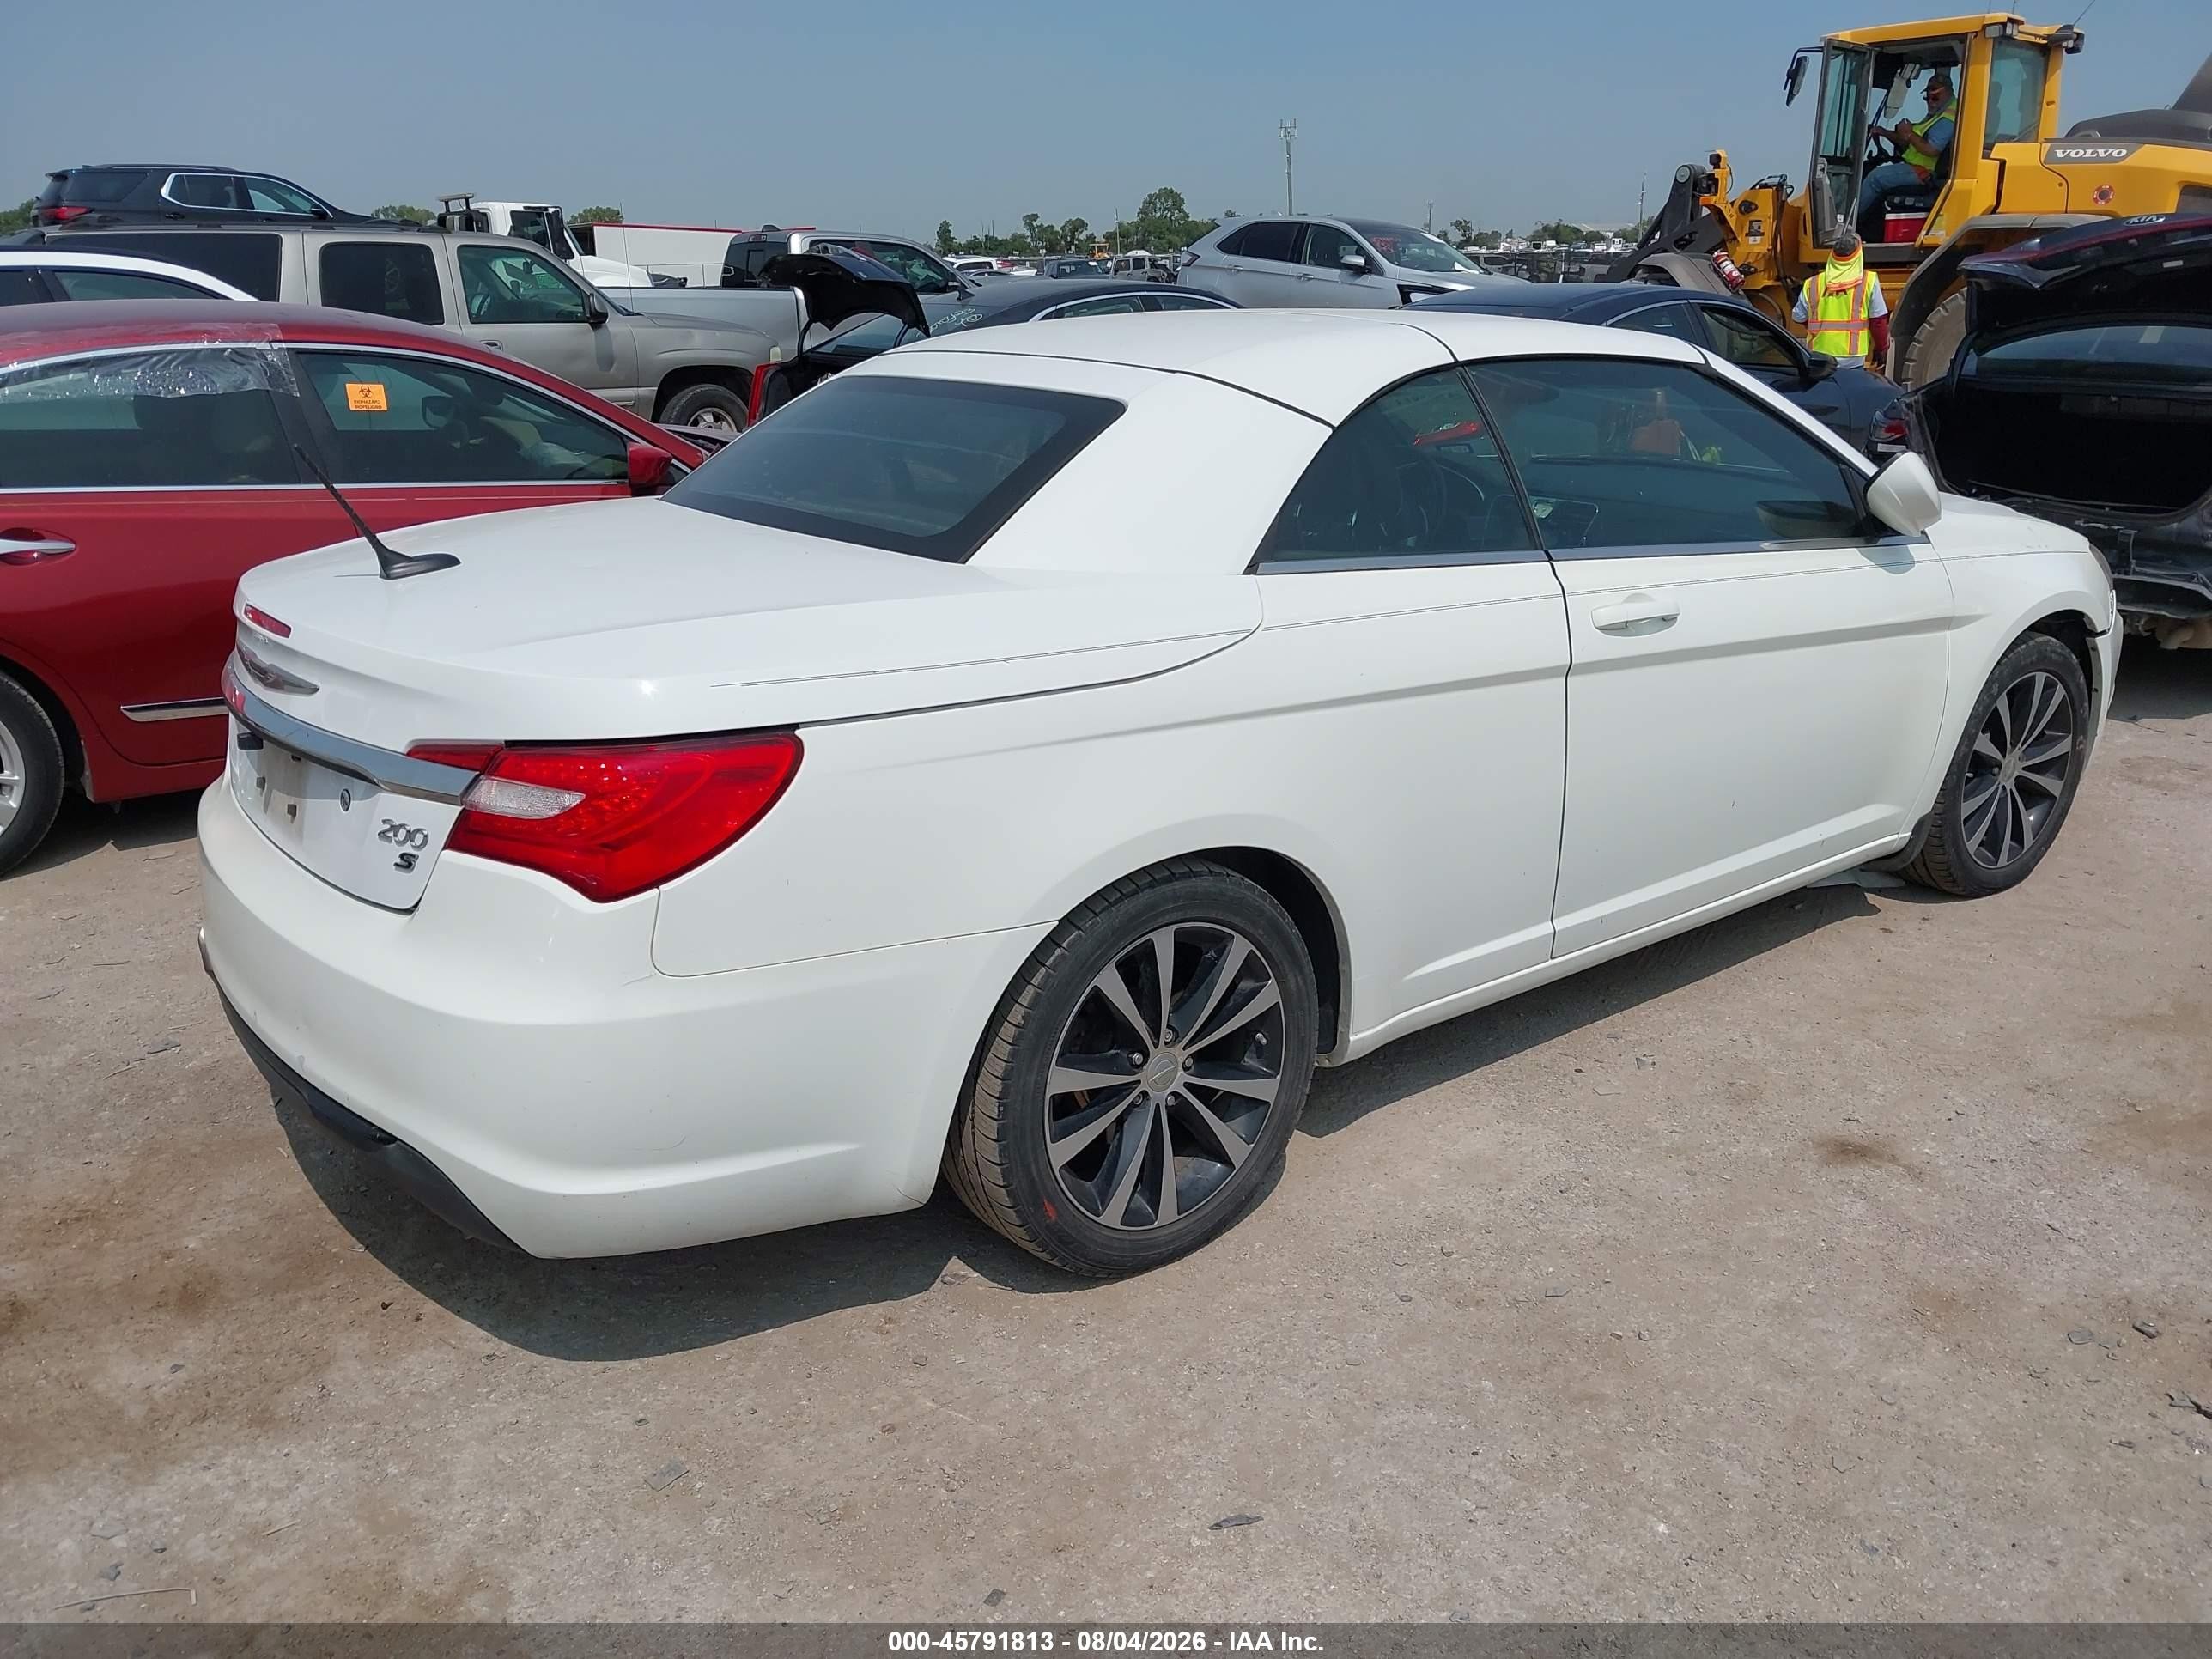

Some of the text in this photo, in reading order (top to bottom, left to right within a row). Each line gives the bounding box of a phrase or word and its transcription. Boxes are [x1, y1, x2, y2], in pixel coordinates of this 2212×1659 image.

[2054, 149, 2128, 158] VOLVO
[2129, 215, 2158, 225] KIA
[377, 818, 429, 852] 200
[392, 852, 420, 874] S
